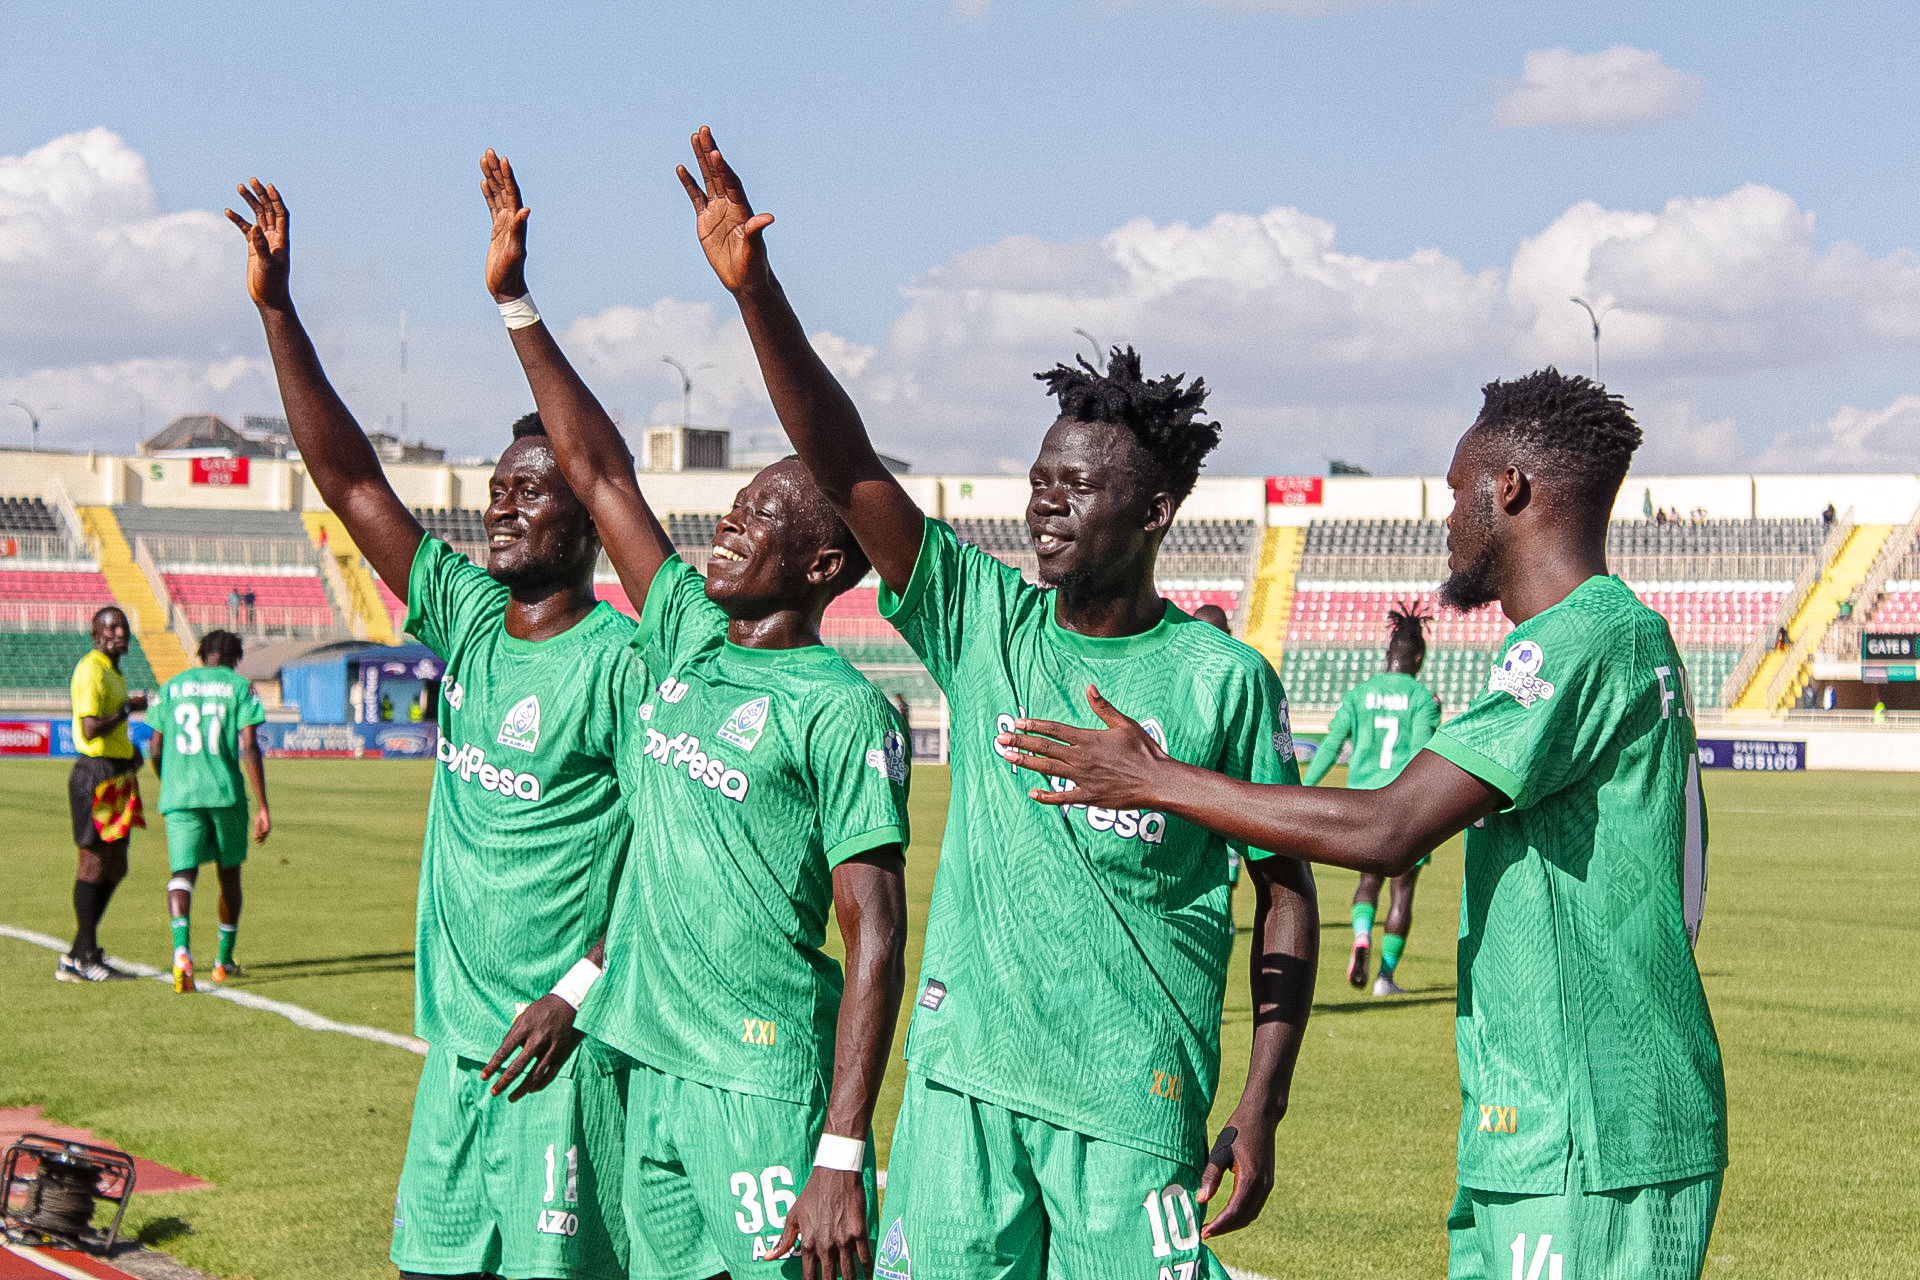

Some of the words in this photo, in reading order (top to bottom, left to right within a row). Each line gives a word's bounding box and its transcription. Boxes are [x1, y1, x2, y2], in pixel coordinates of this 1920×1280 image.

[1275, 477, 1313, 491] GATE
[1868, 639, 1900, 655] GATE
[173, 703, 226, 756] 37
[1374, 716, 1398, 769] 7
[741, 1018, 776, 1046] XXI
[1478, 1104, 1517, 1133] XXI
[543, 1144, 578, 1203] 11
[730, 1165, 797, 1234] 36
[537, 1209, 579, 1236] AZO
[1143, 1184, 1199, 1258] 10
